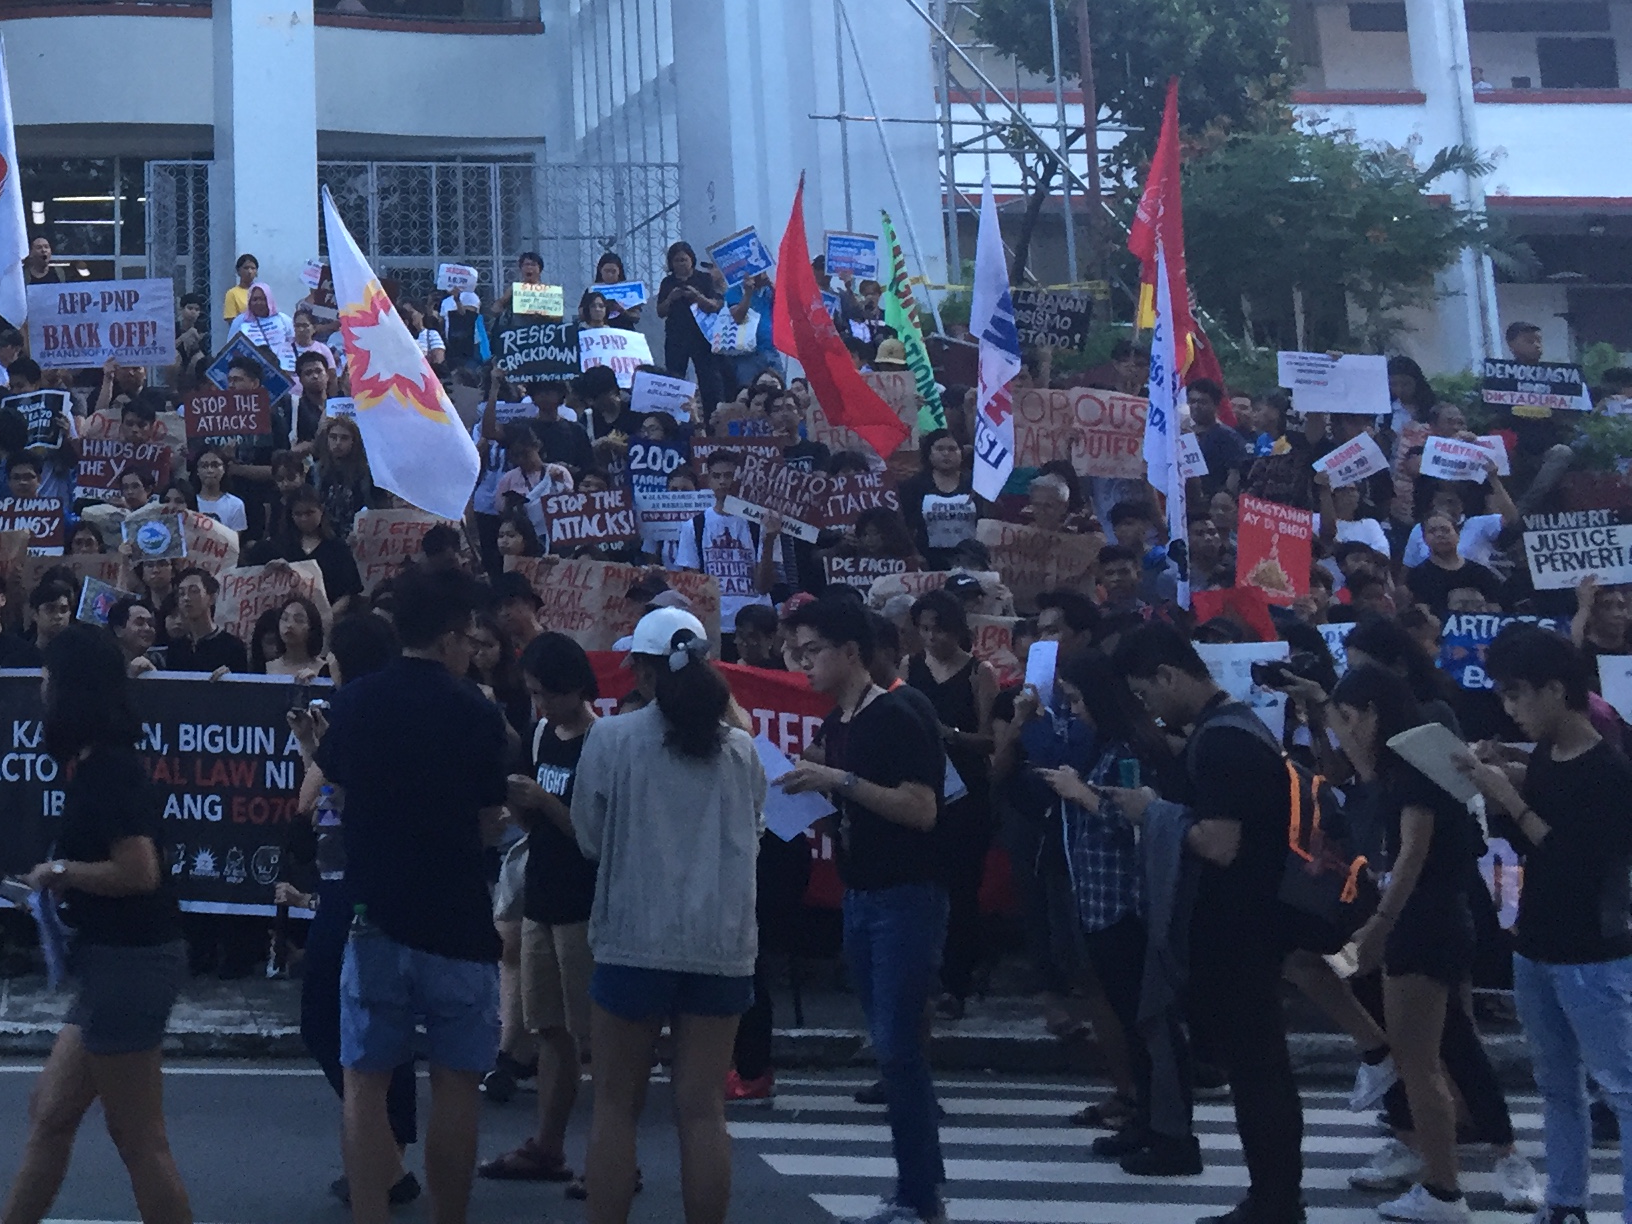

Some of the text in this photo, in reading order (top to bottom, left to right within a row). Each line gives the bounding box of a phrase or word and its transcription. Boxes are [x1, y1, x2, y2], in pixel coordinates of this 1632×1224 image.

[57, 290, 140, 314] AFP-PNP
[1016, 313, 1072, 329] ASISMO
[43, 321, 157, 350] BACK OFF!
[39, 346, 166, 359] #HANDSOFFACTIVISTS
[497, 346, 578, 372] CRACKDOWN
[192, 394, 261, 414] STOP THE
[1075, 394, 1148, 430] OUS
[197, 414, 257, 432] ATTACKS
[83, 439, 133, 459] HANDS
[629, 444, 686, 473] 200+
[79, 461, 106, 476] THE
[854, 472, 884, 489] THE
[15, 496, 61, 511] LUMAD
[547, 490, 624, 514] STOP THE
[193, 513, 213, 531] TO
[552, 509, 636, 543] ATTACKS!
[1243, 512, 1260, 527] AY
[192, 536, 229, 559] LAW
[1530, 528, 1619, 554] JUSTICE
[832, 557, 856, 573] DE
[178, 724, 275, 755] BIGUIN
[194, 757, 258, 788] LAW
[265, 760, 295, 789] NI
[536, 763, 570, 796] FIGHT
[162, 792, 223, 821] ANG
